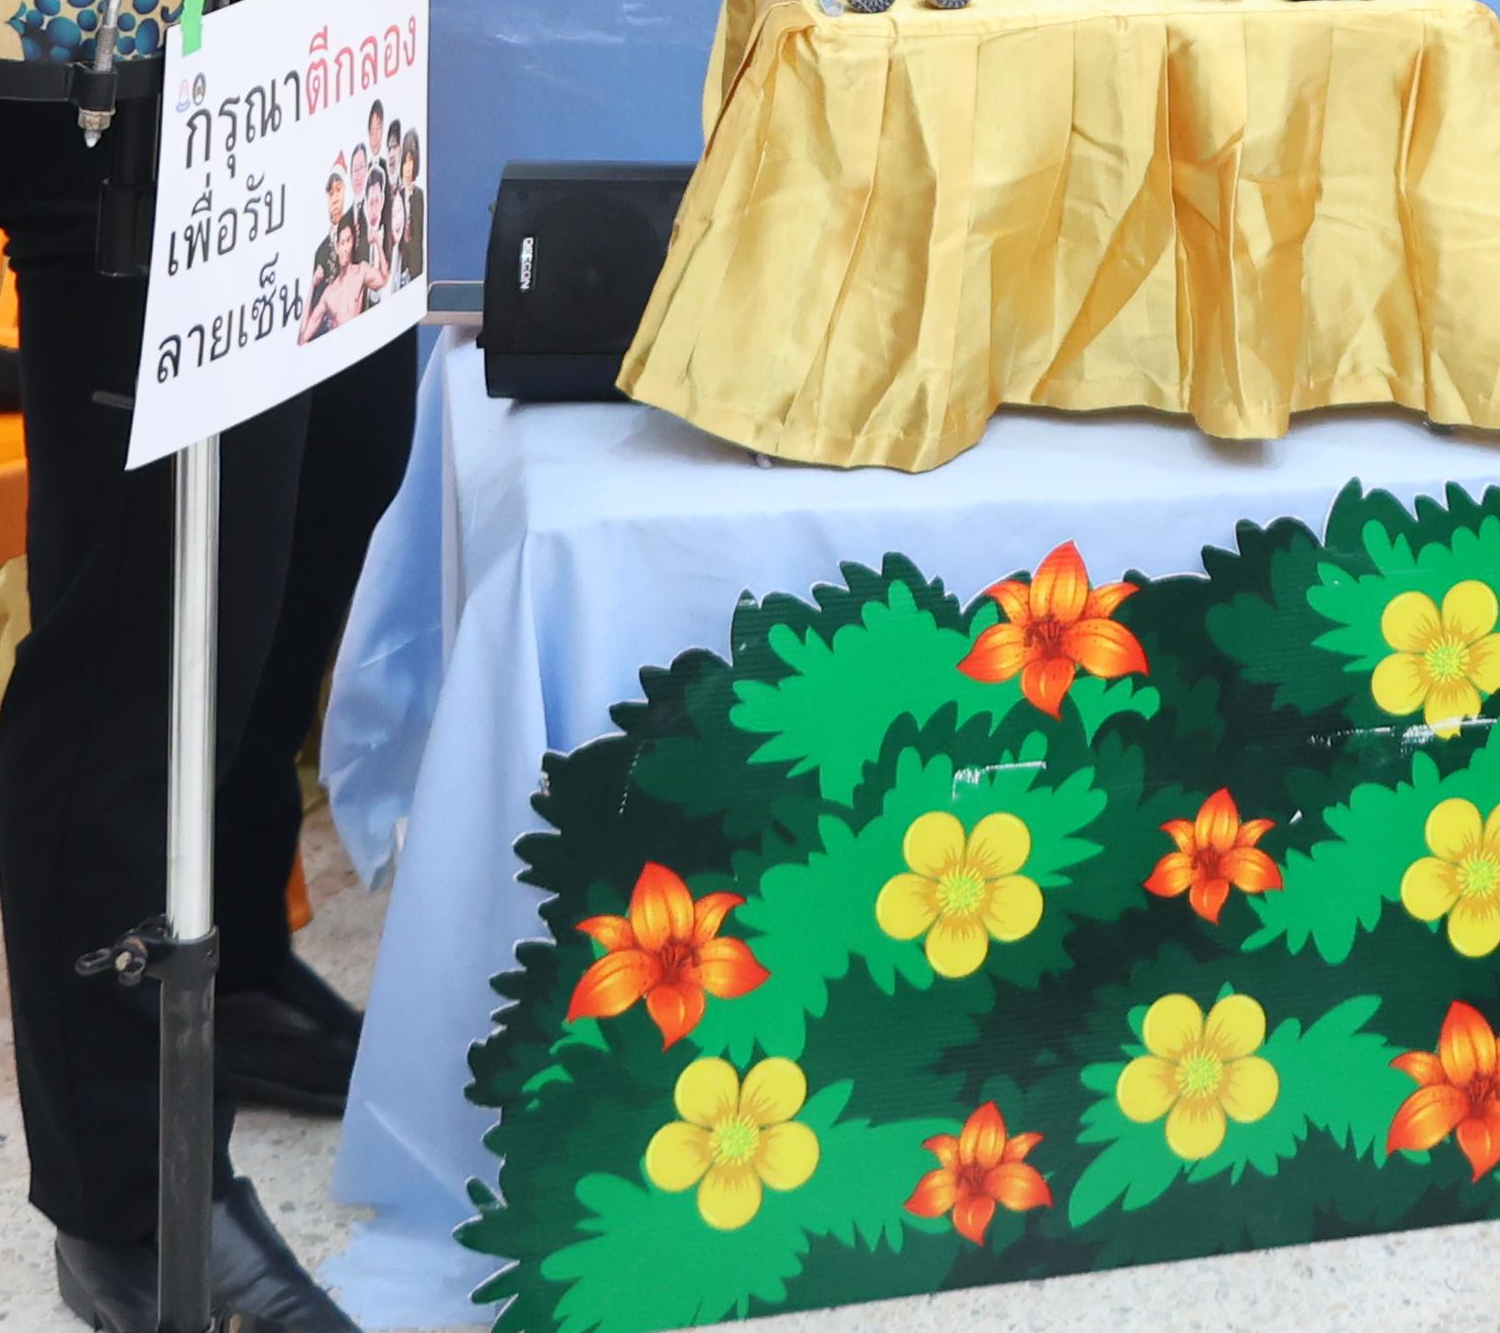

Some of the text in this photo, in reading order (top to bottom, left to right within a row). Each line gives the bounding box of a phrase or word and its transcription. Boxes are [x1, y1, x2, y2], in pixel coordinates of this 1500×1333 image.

[166, 171, 288, 278] เพื่อรับ
[155, 253, 305, 384] ลายเซ็น
